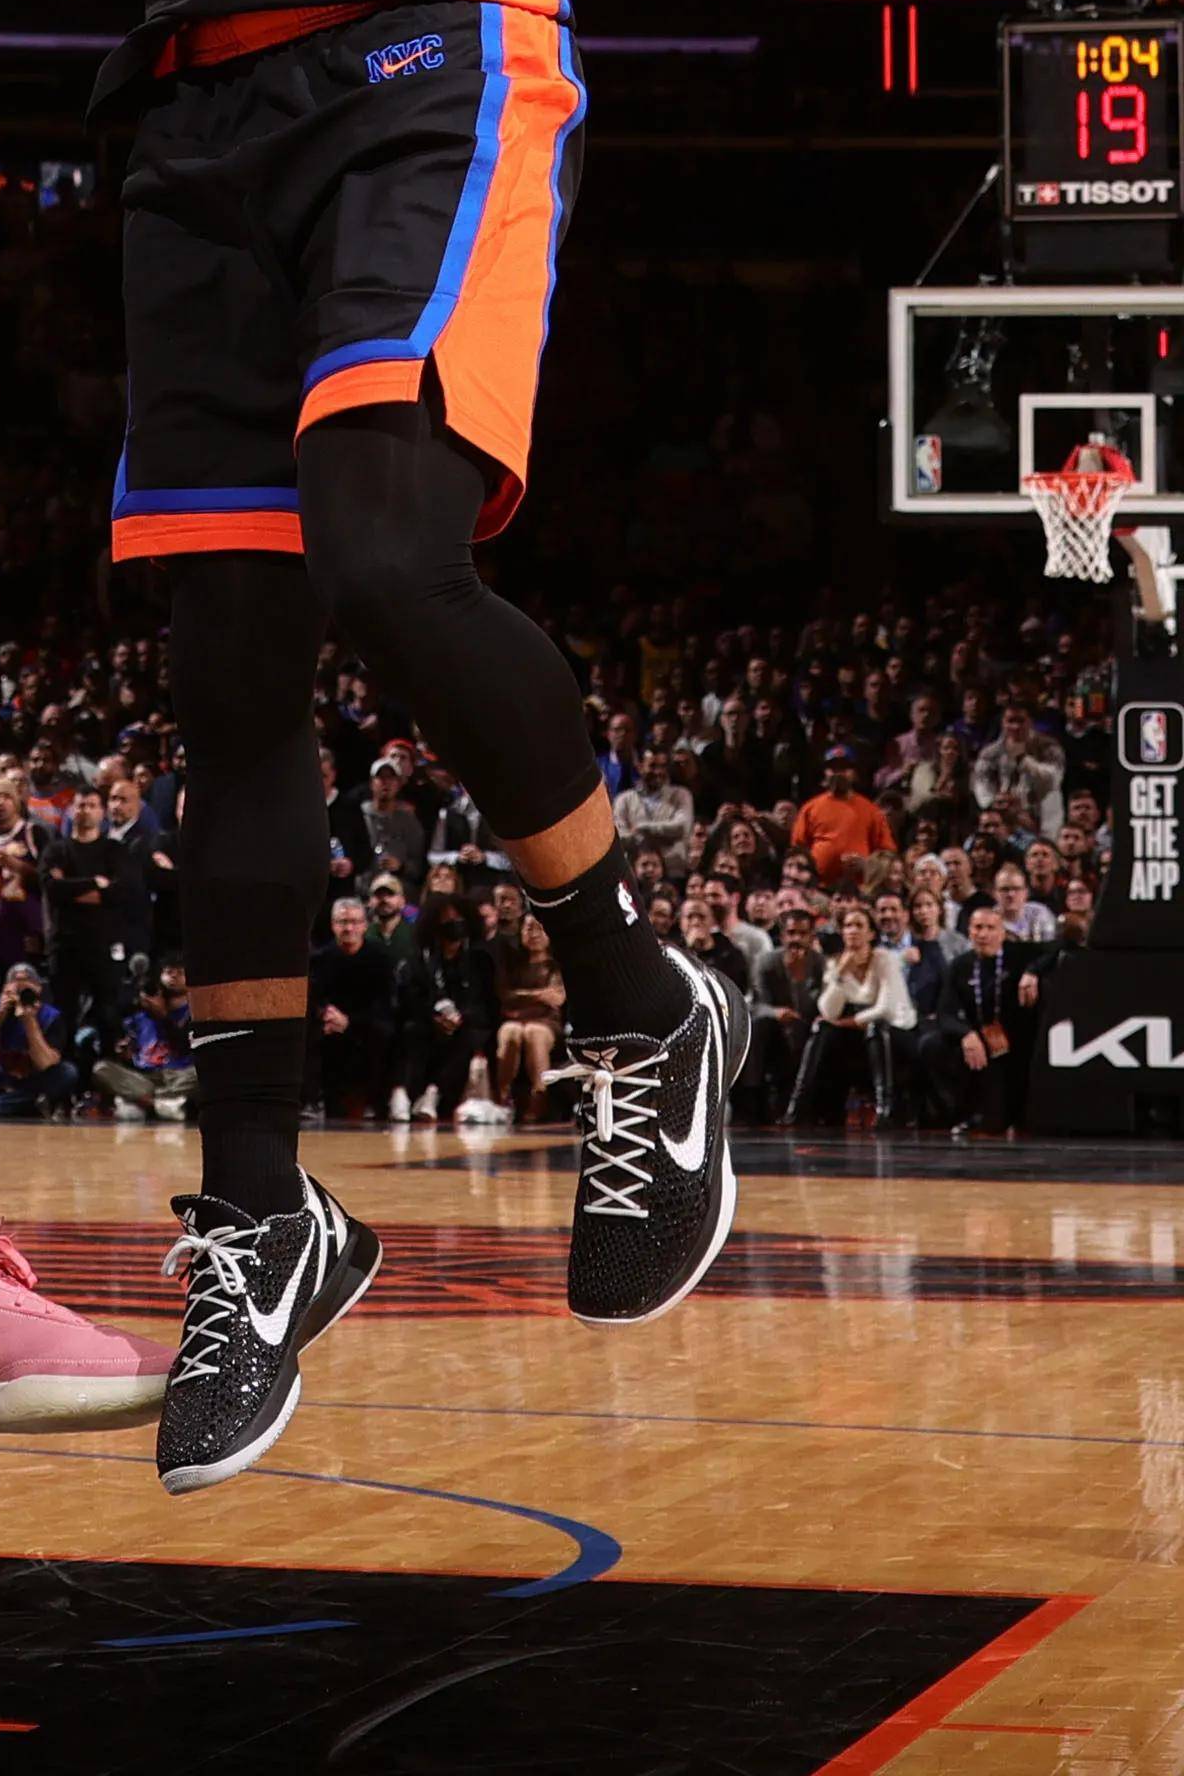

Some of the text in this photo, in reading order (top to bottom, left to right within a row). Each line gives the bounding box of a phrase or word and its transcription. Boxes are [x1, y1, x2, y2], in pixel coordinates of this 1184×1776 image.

[365, 34, 445, 84] NYC
[1077, 35, 1159, 83] 1:04
[1077, 85, 1147, 165] 19
[1061, 180, 1174, 204] TISSOT
[1130, 776, 1176, 816] GET
[1130, 820, 1178, 859] THE
[1130, 861, 1180, 901] APP
[1048, 1016, 1184, 1068] KI
